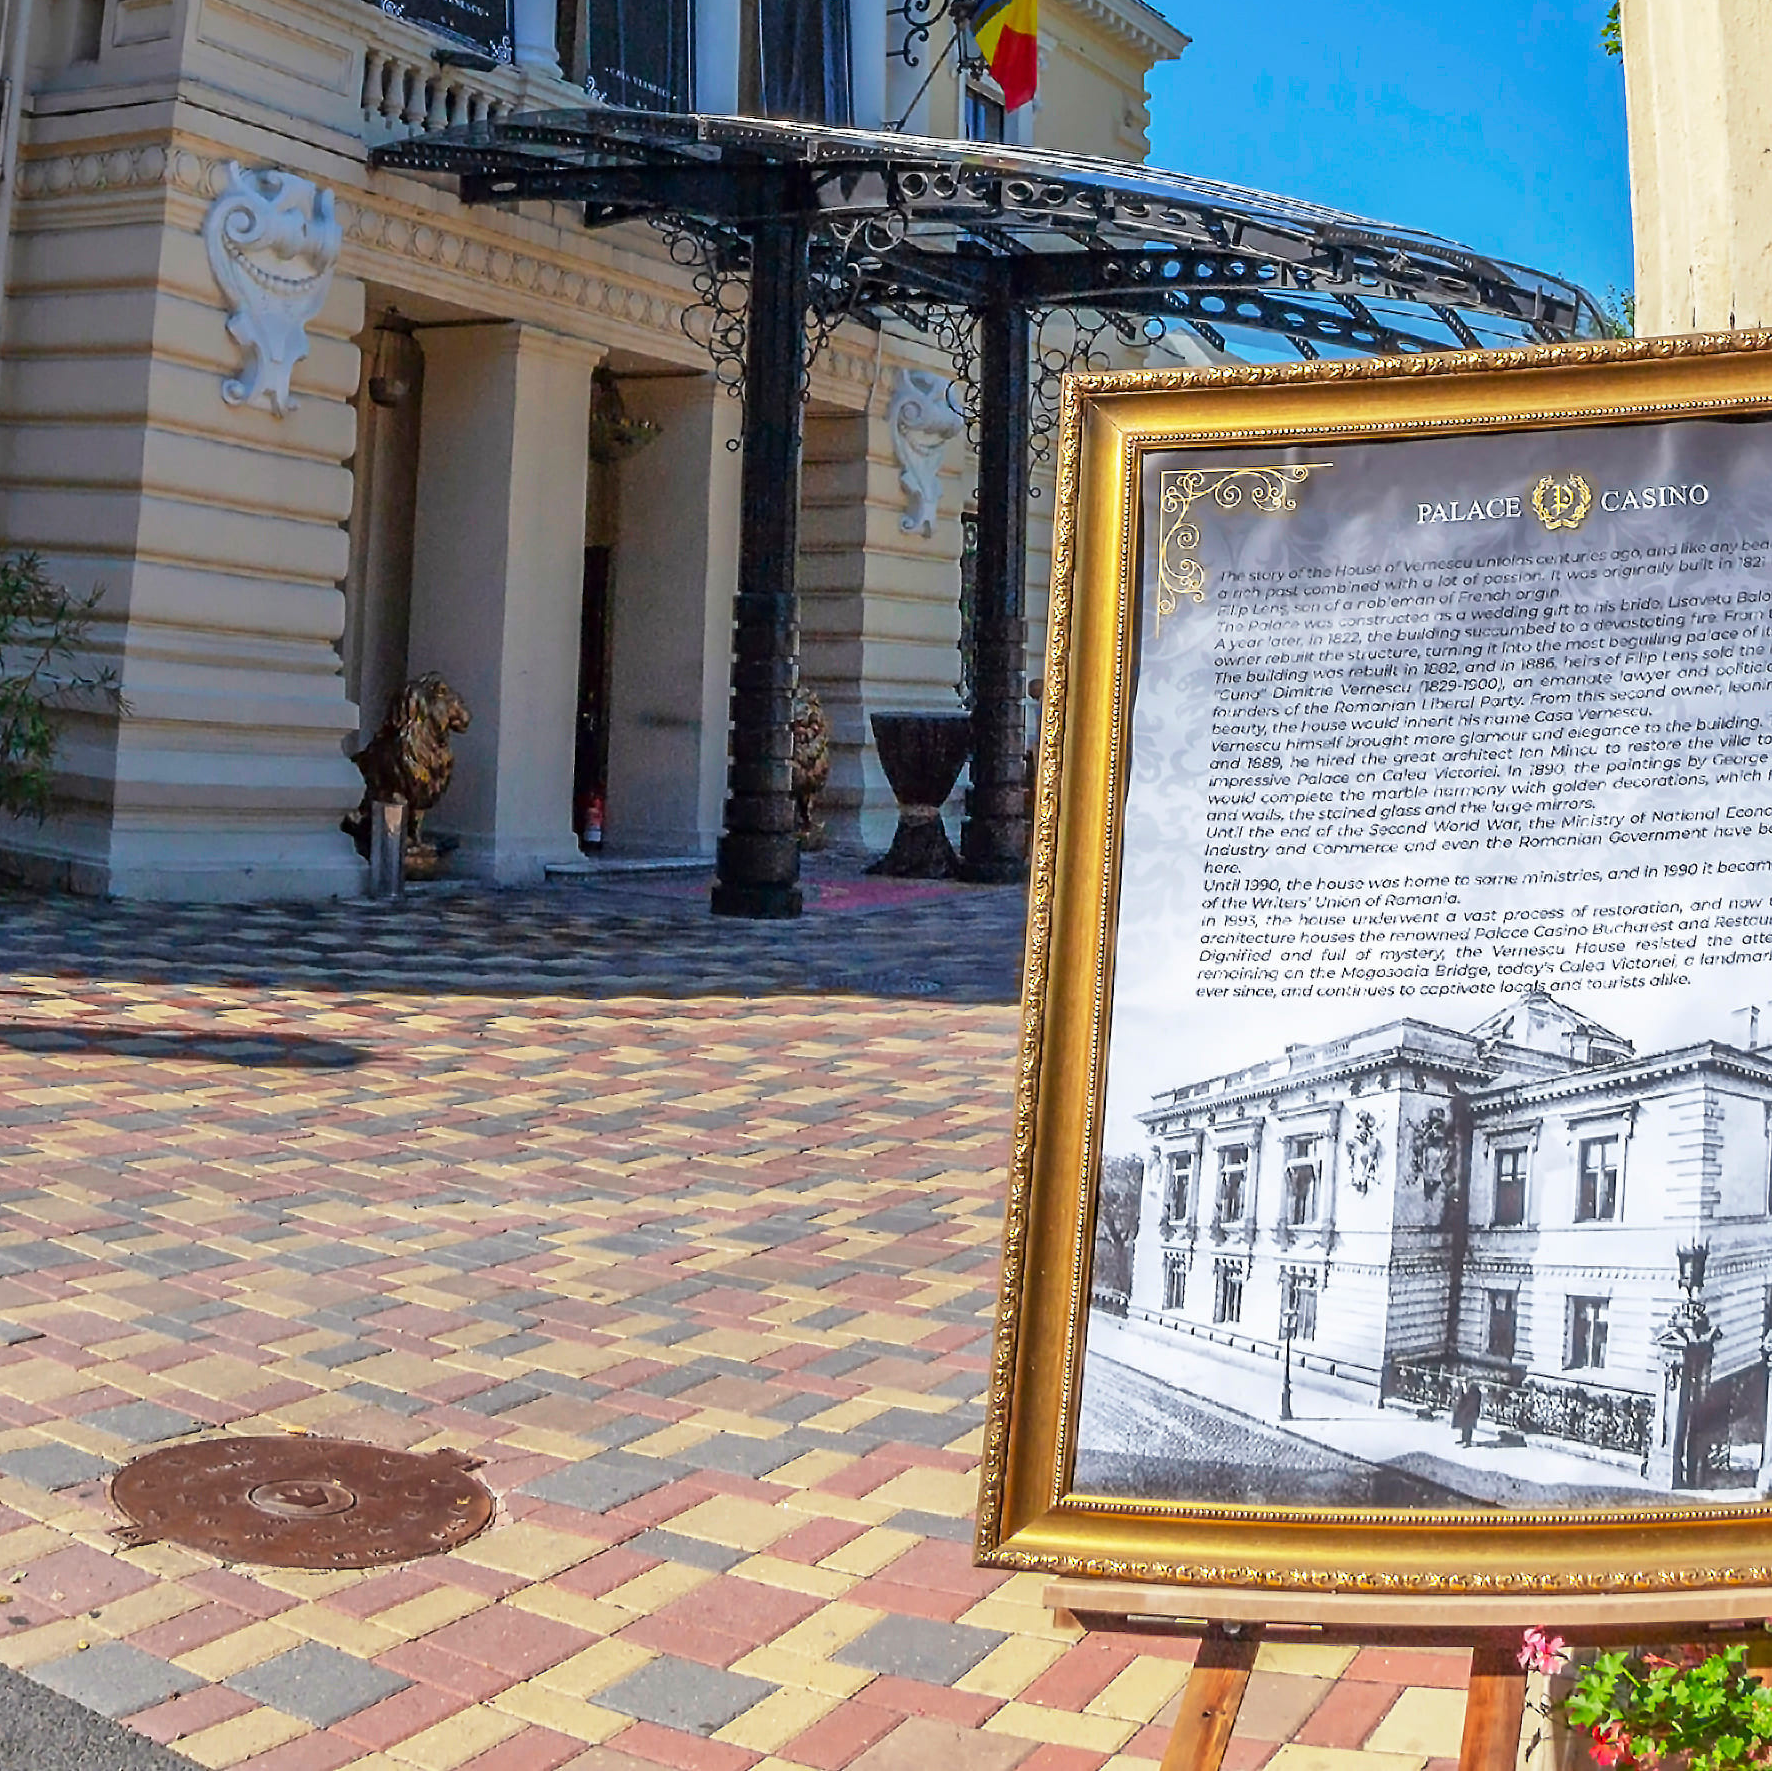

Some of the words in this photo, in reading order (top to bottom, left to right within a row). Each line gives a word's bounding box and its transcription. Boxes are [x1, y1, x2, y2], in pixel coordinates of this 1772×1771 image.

[1416, 495, 1522, 525] PALACE
[1600, 483, 1710, 513] CASINO
[1247, 568, 1285, 582] story
[1680, 542, 1706, 555] like
[1708, 543, 1737, 555] any
[1678, 559, 1713, 572] built
[1542, 603, 1569, 618] gift
[1395, 627, 1461, 643] building
[1424, 644, 1483, 659] turning
[1501, 641, 1532, 653] into
[1565, 637, 1605, 649] most
[1215, 671, 1242, 683] The
[1244, 669, 1308, 684] building
[1464, 660, 1496, 672] and
[1562, 654, 1601, 667] heirs
[1339, 681, 1412, 695] Vernescu
[1618, 667, 1670, 684] lawyer
[1676, 665, 1708, 678] and
[1576, 689, 1605, 702] this
[1300, 719, 1347, 732] house
[1533, 708, 1574, 721] Casa
[1577, 704, 1653, 719] Vernescu.
[1210, 739, 1281, 752] Vernescu
[1413, 735, 1455, 745] more
[1695, 715, 1763, 733] building.
[1208, 757, 1240, 769] and
[1315, 754, 1355, 766] hired
[1392, 751, 1436, 766] great
[1442, 747, 1513, 761] architect
[1719, 733, 1751, 747] villa
[1296, 771, 1350, 784] Palace
[1605, 757, 1681, 774] paintings
[1686, 754, 1707, 769] by
[1259, 789, 1333, 805] complete
[1371, 786, 1428, 799] marble
[1510, 781, 1546, 794] with
[1551, 778, 1607, 794] golden
[1715, 768, 1762, 783] which
[1279, 825, 1311, 837] end
[1368, 821, 1427, 835] Second
[1432, 819, 1480, 833] World
[1485, 818, 1522, 832] War,
[1560, 813, 1624, 830] Ministry
[1651, 807, 1720, 823] National
[1318, 805, 1377, 818] stained
[1379, 804, 1421, 819] glass
[1203, 844, 1269, 858] Industry
[1275, 843, 1307, 855] and
[1441, 840, 1479, 850] even
[1608, 826, 1707, 843] Government
[1202, 879, 1240, 890] Until
[1316, 877, 1365, 889] house
[1403, 874, 1450, 887] home
[1607, 866, 1639, 879] and
[1662, 863, 1698, 876] 1990
[1203, 861, 1242, 873] here.
[1221, 896, 1248, 908] the
[1314, 895, 1362, 907] Union
[1384, 892, 1461, 906] Romania.
[1298, 913, 1346, 925] house
[1462, 909, 1496, 921] vast
[1592, 901, 1683, 918] restoration,
[1728, 898, 1762, 909] now
[1199, 931, 1296, 943] architecture
[1299, 930, 1355, 943] houses
[1474, 925, 1529, 939] Palace
[1533, 923, 1588, 937] Casino
[1677, 917, 1709, 930] and
[1491, 942, 1566, 957] Vernescu
[1575, 939, 1626, 953] House
[1434, 963, 1492, 979] Bridge,
[1195, 987, 1228, 996] ever
[1232, 986, 1277, 998] since,
[1499, 979, 1546, 993] locals
[1648, 972, 1691, 987] alike.
